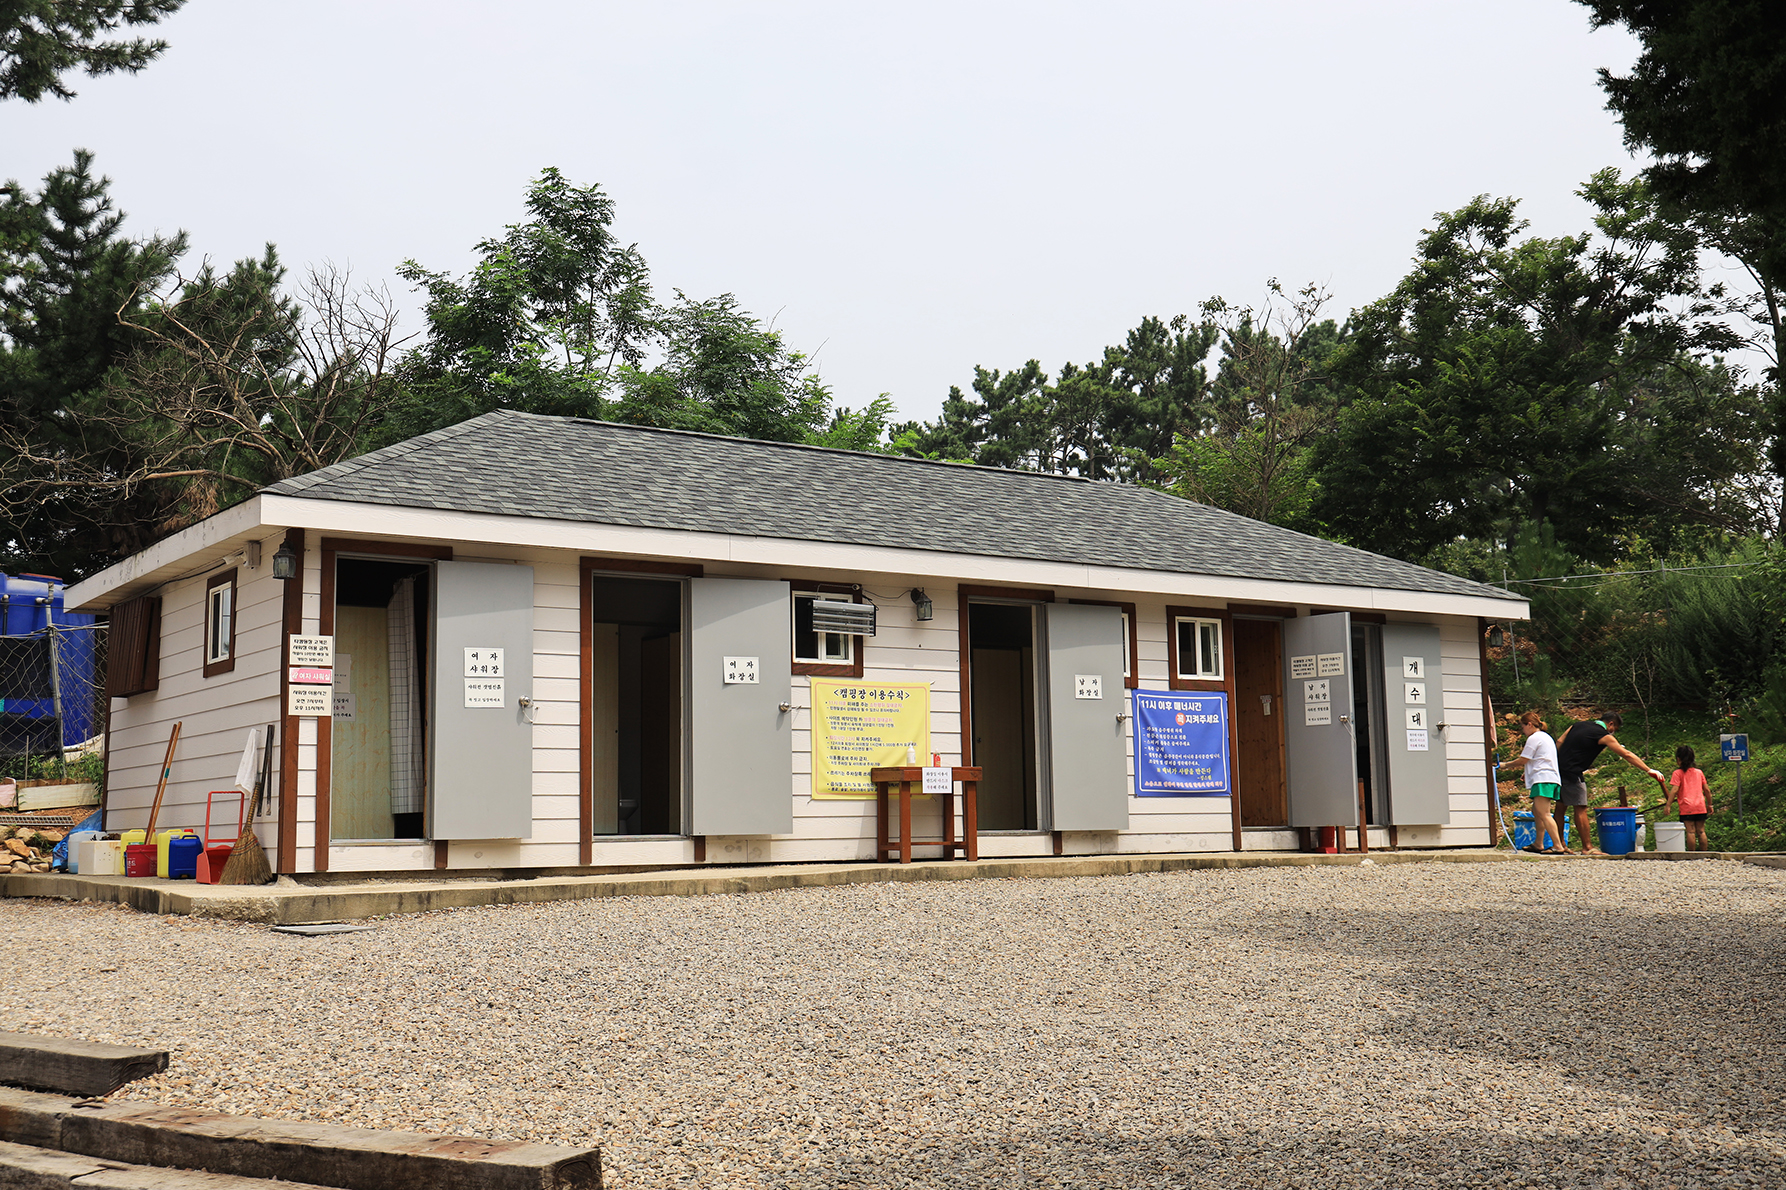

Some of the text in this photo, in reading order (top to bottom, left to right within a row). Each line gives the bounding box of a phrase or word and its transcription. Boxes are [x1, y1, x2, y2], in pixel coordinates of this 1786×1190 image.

[470, 664, 499, 674] 샤워장
[729, 672, 755, 681] 화장실
[869, 689, 910, 700] 이용수칙>
[1078, 688, 1099, 697] 화장실
[1141, 700, 1202, 712] 11시 이후 매너시간
[1177, 714, 1220, 724] 꼭 지켜주세요
